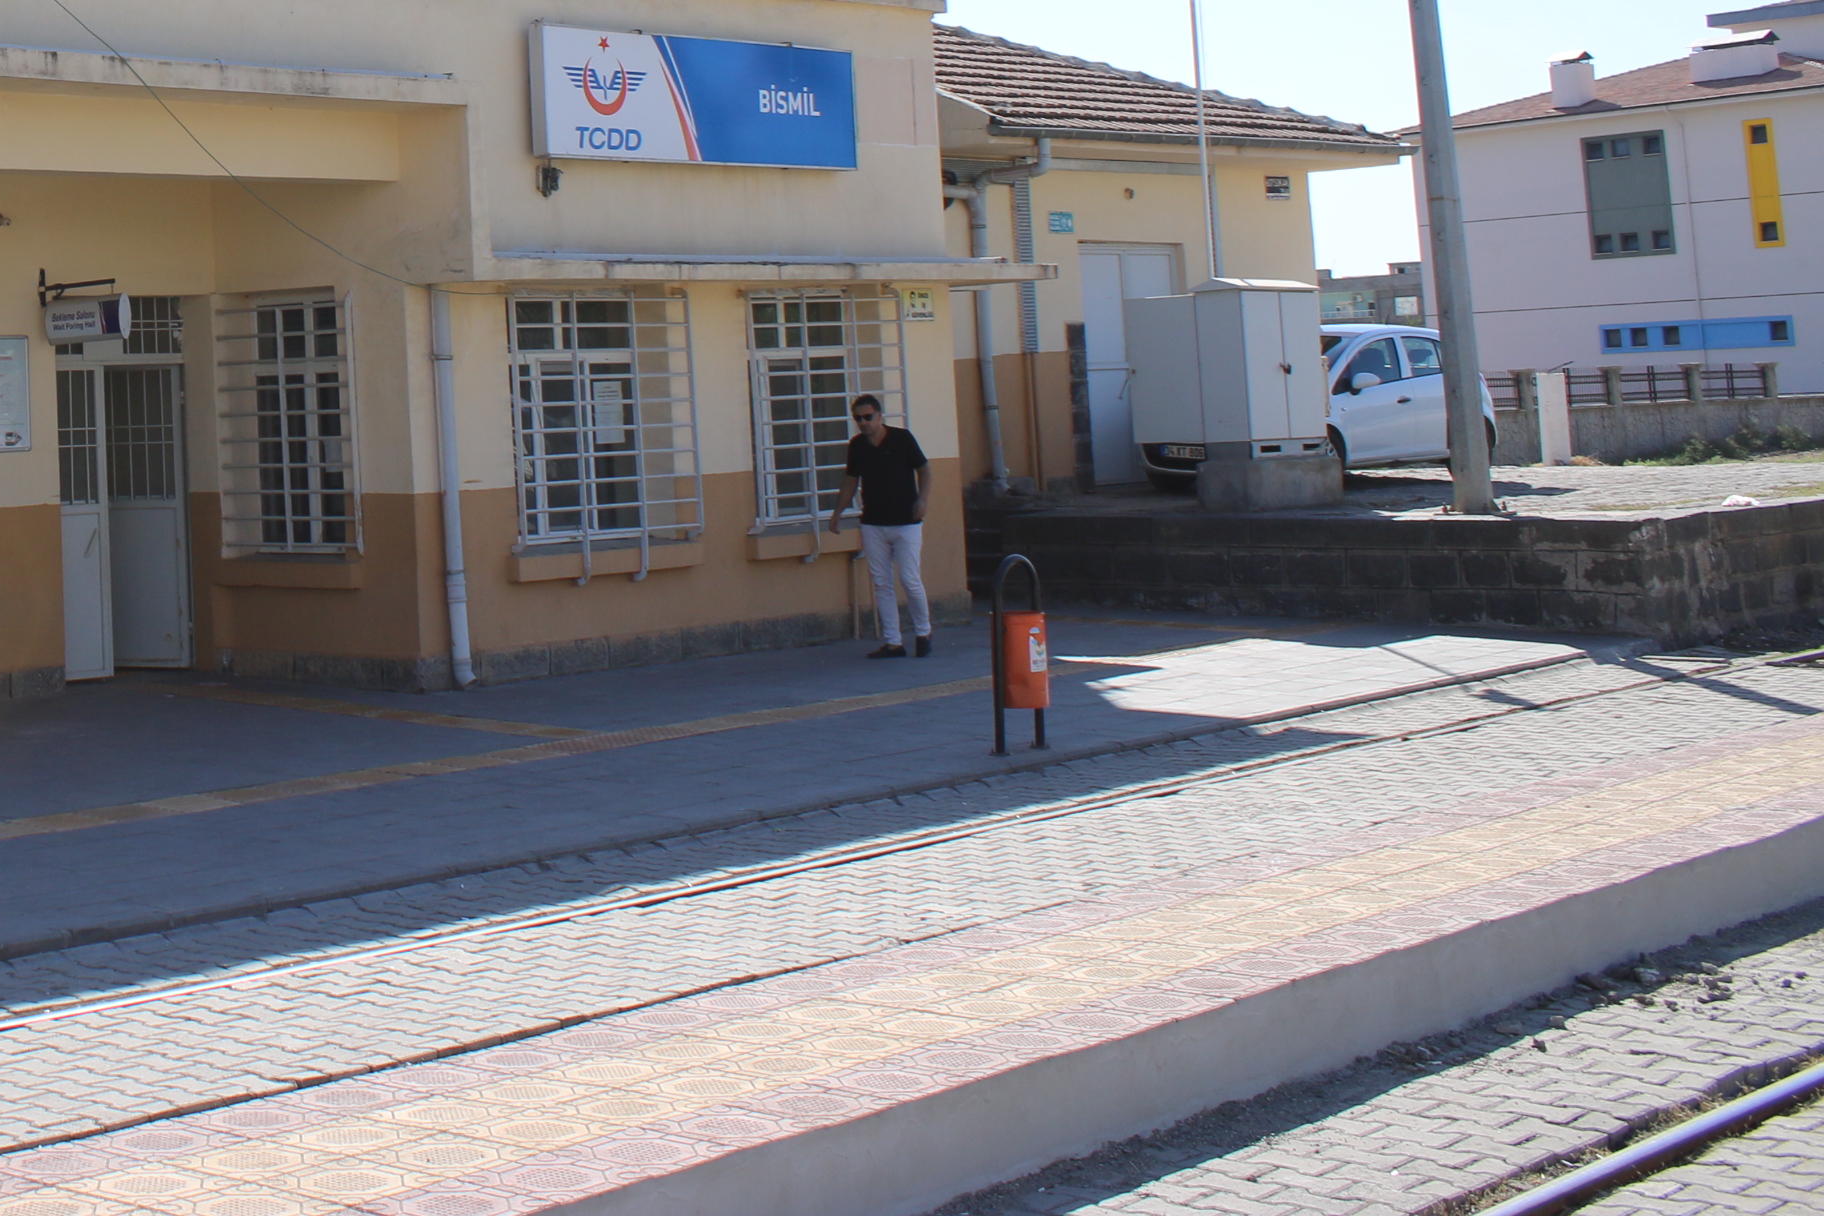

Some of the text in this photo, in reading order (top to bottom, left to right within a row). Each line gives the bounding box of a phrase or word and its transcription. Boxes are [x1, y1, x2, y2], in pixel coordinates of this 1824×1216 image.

[758, 85, 821, 116] BİSMİL
[575, 126, 642, 151] TCDD
[52, 310, 96, 322] Bekleme Salonu
[53, 323, 65, 331] Wait
[85, 320, 96, 328] Hall
